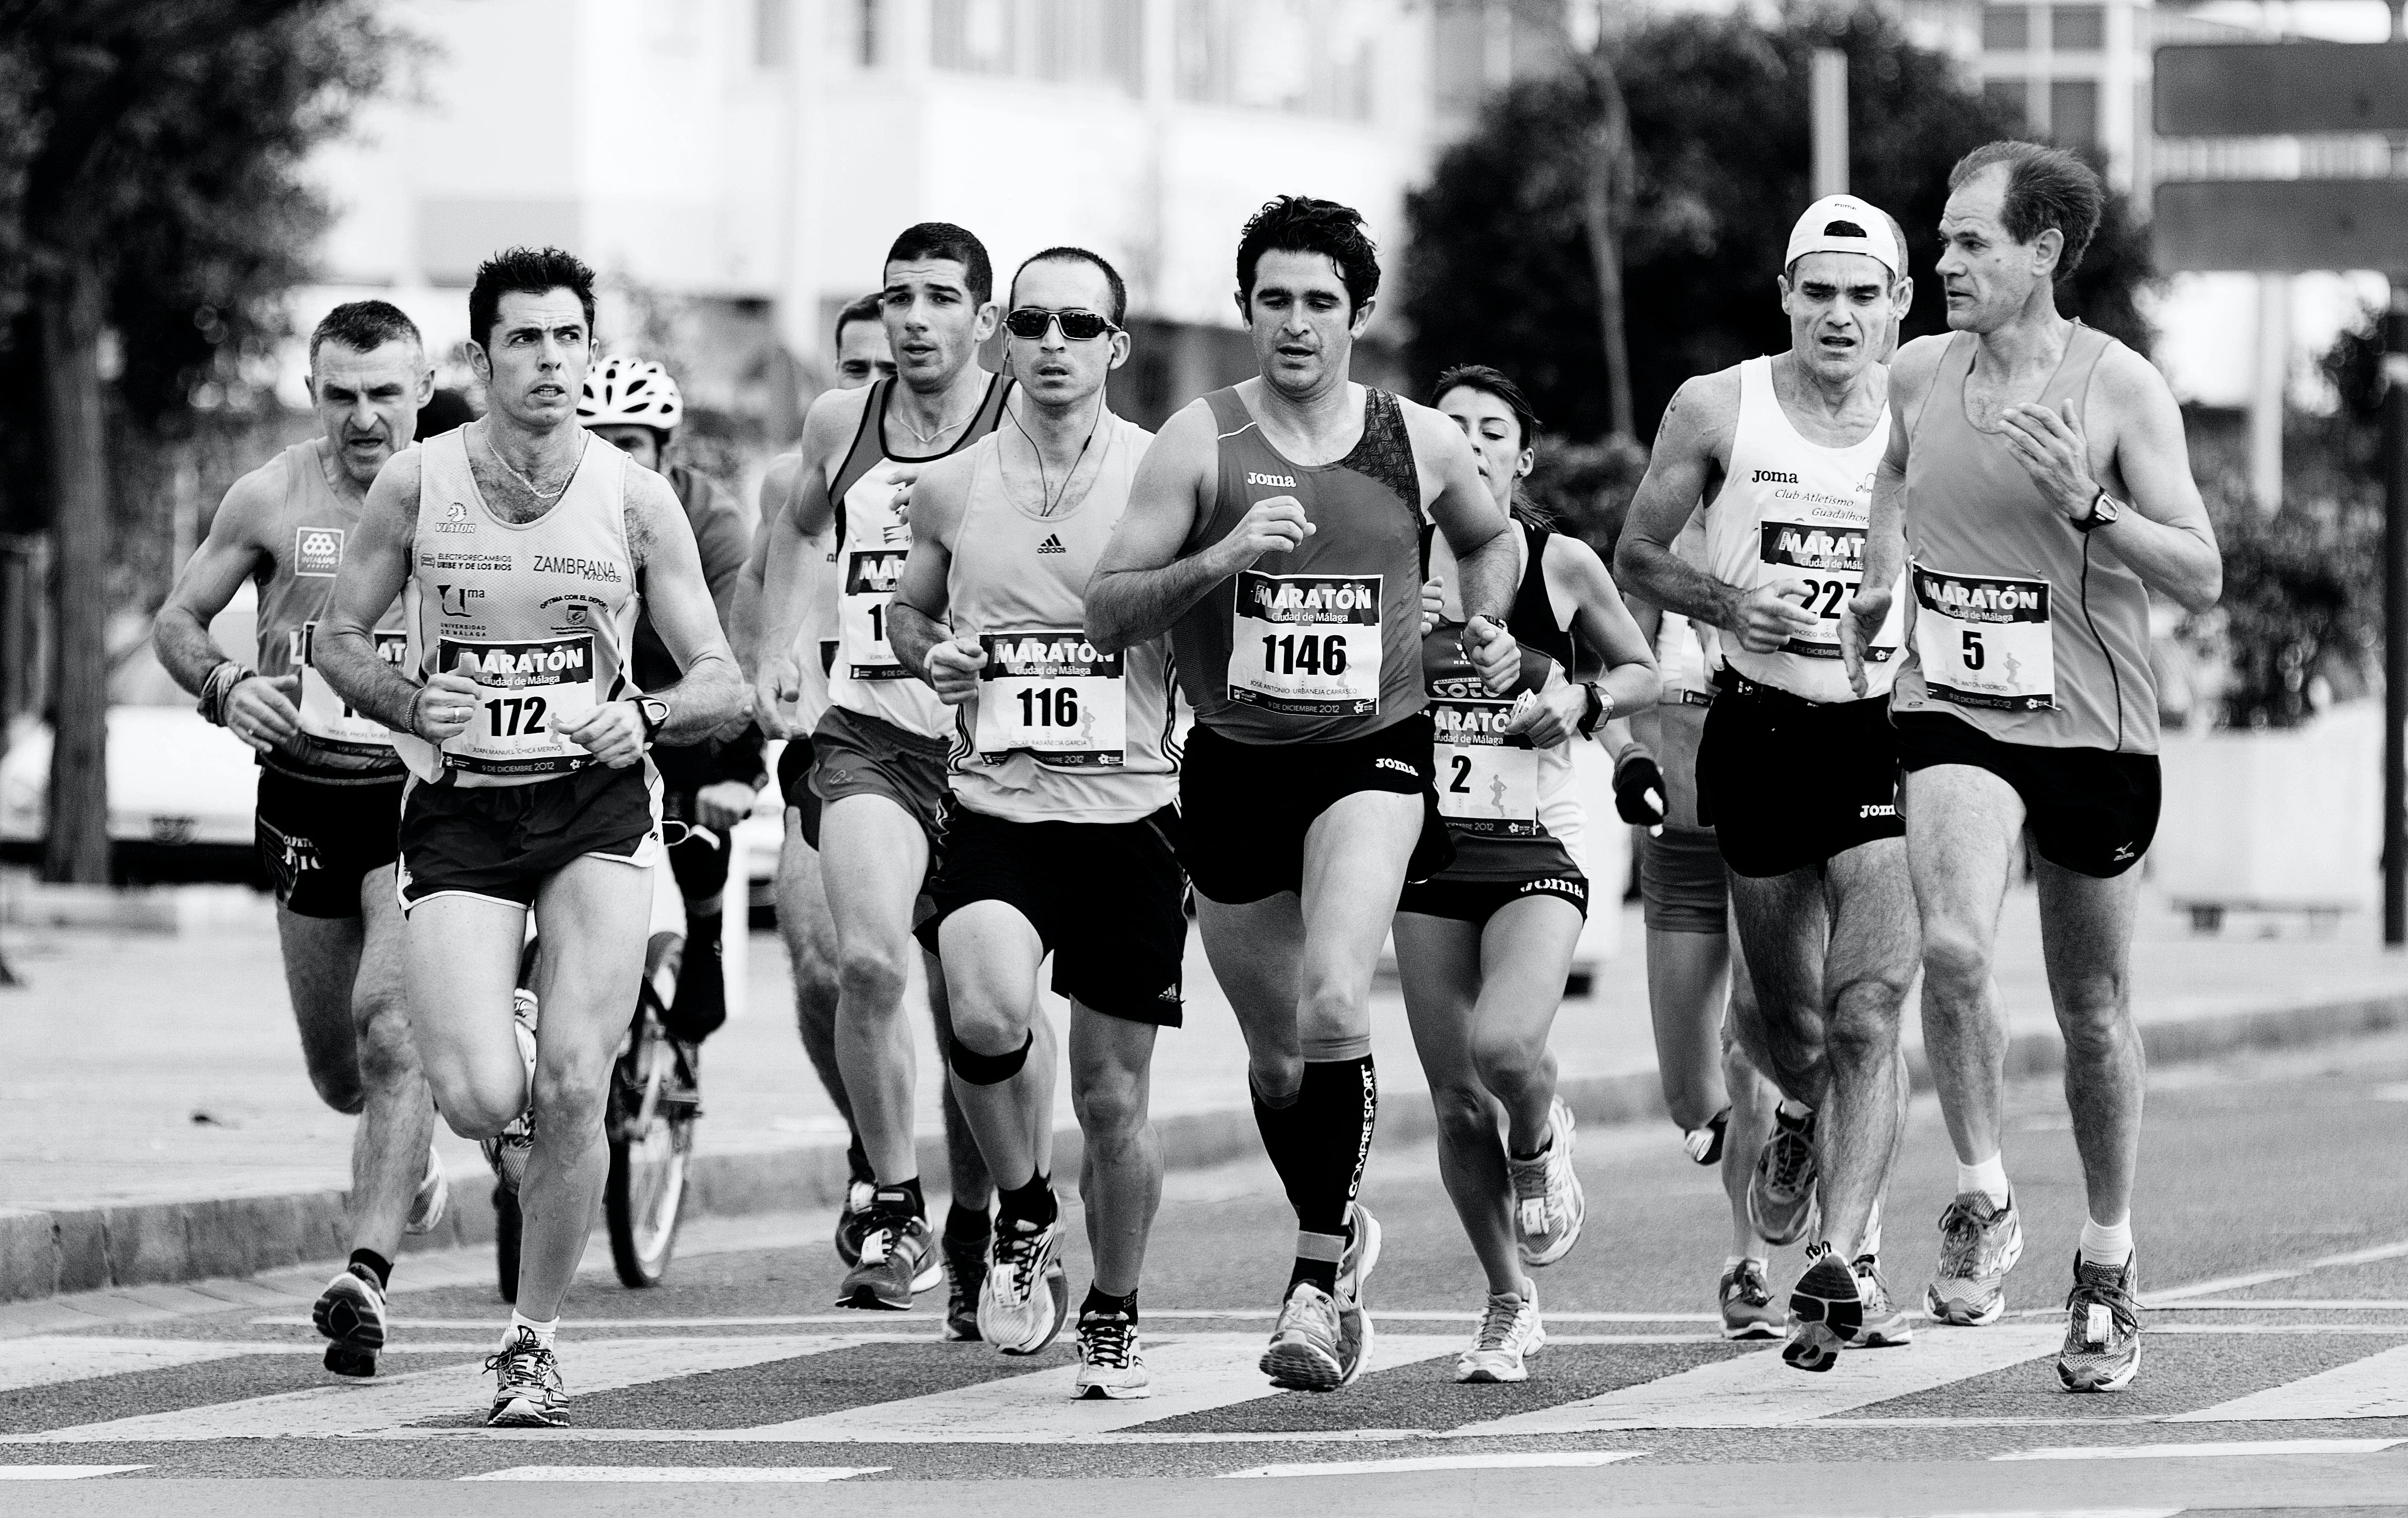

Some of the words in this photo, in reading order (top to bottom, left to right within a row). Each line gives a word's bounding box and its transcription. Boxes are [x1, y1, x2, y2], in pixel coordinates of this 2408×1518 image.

[1247, 472, 1297, 487] Joma
[1775, 489, 1800, 499] Club
[1802, 493, 1854, 507] Atletismo
[435, 522, 476, 533] VIATOR
[1783, 532, 1865, 558] MARAT
[438, 553, 512, 562] ELECTRORECAMBIOS
[1800, 557, 1830, 568] Ciudad
[1831, 560, 1843, 569] de
[1844, 559, 1864, 570] Mála
[494, 563, 512, 571] RIOS
[533, 555, 616, 577] ZAMBRANA
[583, 571, 622, 583] Motos
[1259, 583, 1372, 610] MARATÓN
[1928, 582, 2038, 610] MARATÓN
[1272, 612, 1300, 622] Ciudad
[1302, 613, 1314, 622] de
[1316, 613, 1349, 624] Málaga
[1944, 606, 1969, 619] Ciudad
[1971, 611, 1981, 620] de
[1982, 612, 2014, 623] Málaga
[1262, 634, 1347, 676] 1146
[1963, 630, 1985, 670] 5
[1015, 666, 1045, 675] Ciudad
[1046, 666, 1057, 675] de
[1058, 666, 1091, 677] Málaga
[482, 676, 514, 686] Ciudad
[515, 676, 526, 686] de
[527, 675, 561, 685] Málaga
[1264, 685, 1291, 694] ANTONIO
[1017, 687, 1078, 727] 116
[1282, 704, 1317, 712] DICIEMBRE
[1319, 705, 1340, 713] 2012
[1993, 699, 2012, 709] 2012
[485, 697, 546, 737] 172
[1460, 734, 1472, 744] de
[1472, 735, 1503, 746] Málaga
[1064, 755, 1084, 763] 2012
[534, 762, 555, 771] 2012
[1450, 755, 1472, 794] 2
[1860, 804, 1896, 818] Jom
[1474, 823, 1494, 831] 2012
